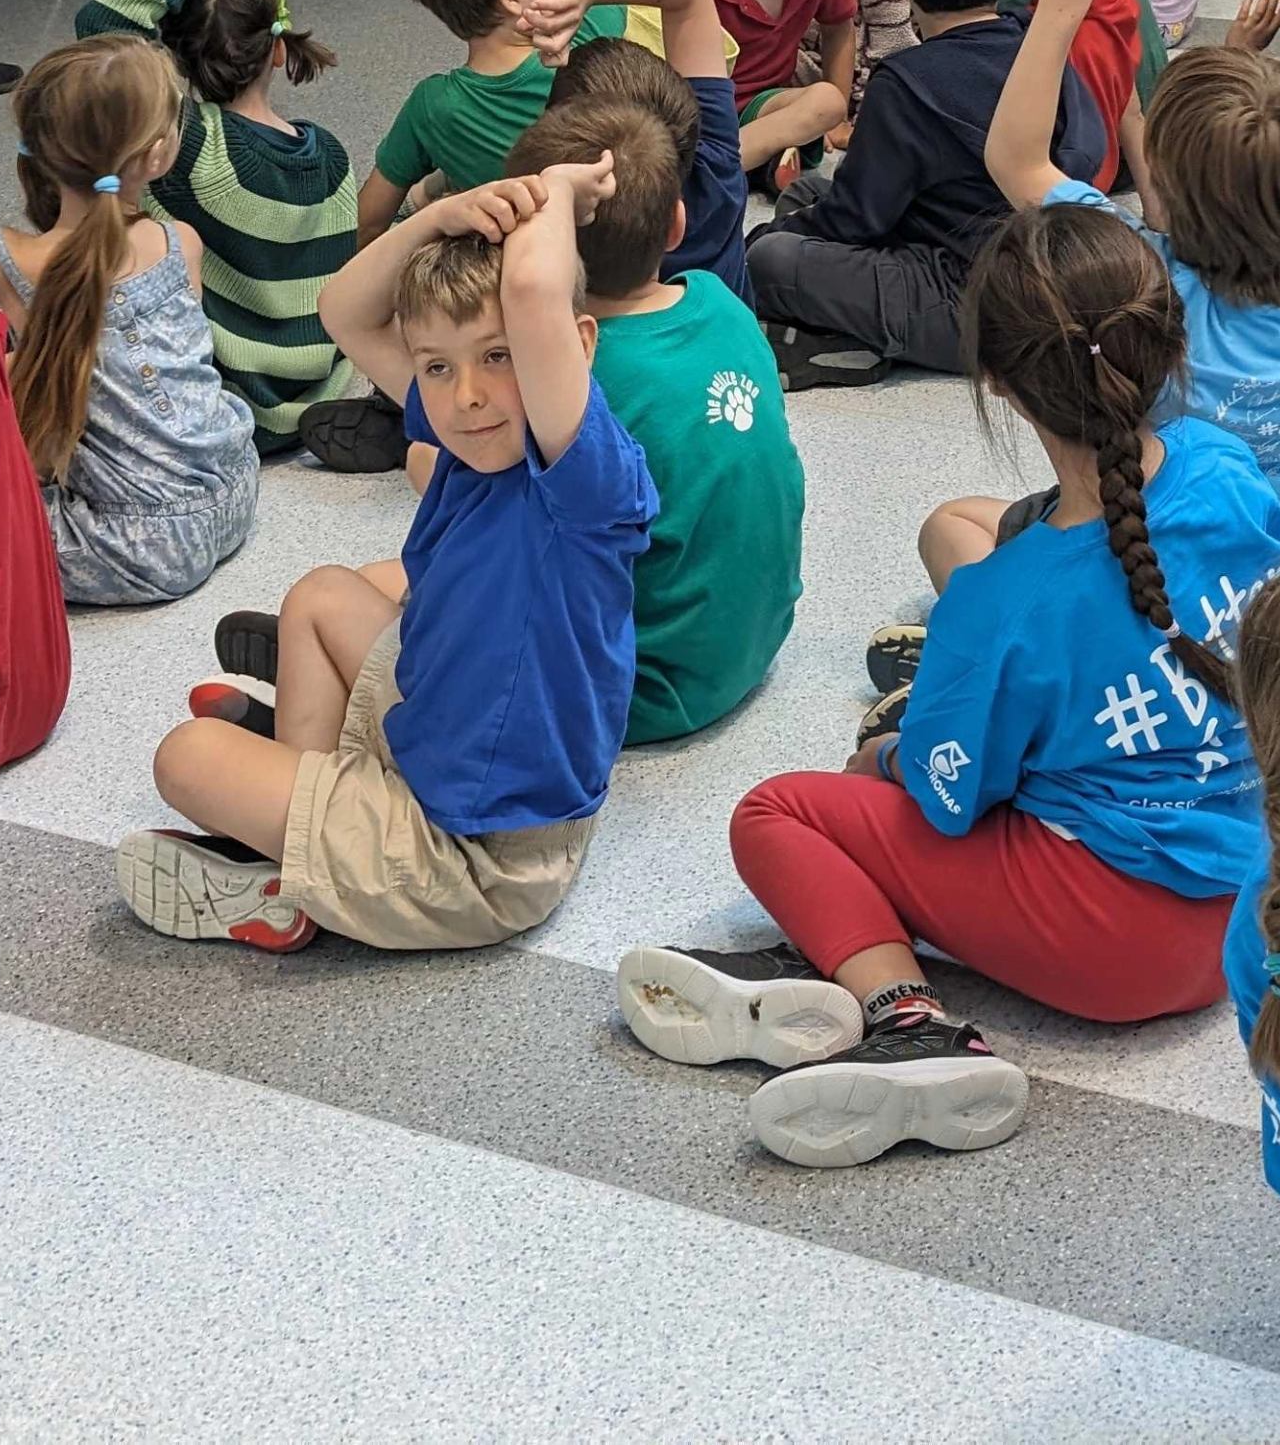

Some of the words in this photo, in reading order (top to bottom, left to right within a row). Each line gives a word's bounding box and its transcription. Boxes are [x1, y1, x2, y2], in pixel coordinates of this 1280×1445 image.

[706, 370, 738, 400] belize
[740, 373, 760, 400] zoo
[705, 398, 723, 425] the
